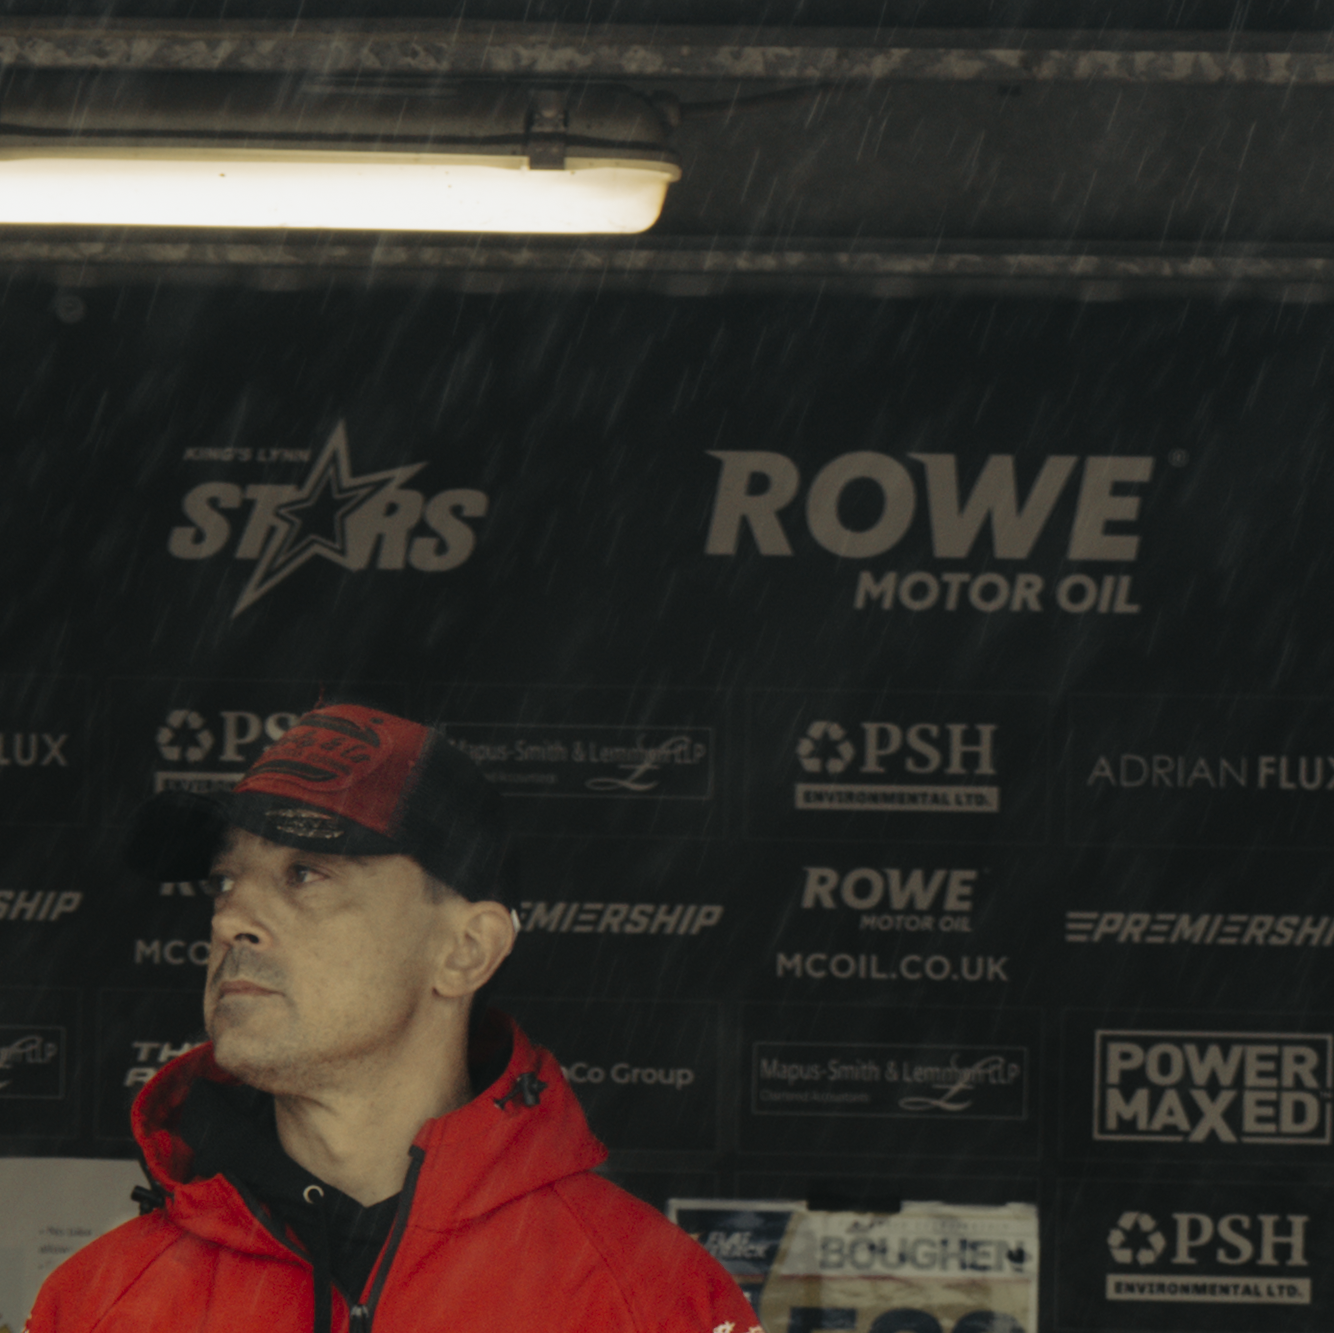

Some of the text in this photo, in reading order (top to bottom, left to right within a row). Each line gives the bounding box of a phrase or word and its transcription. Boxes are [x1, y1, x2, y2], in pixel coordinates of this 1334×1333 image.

[705, 450, 1155, 561] ROWE
[854, 570, 1141, 614] MOTOR OIL
[860, 723, 998, 777] PSH
[1087, 754, 1247, 789] ADRIAN
[802, 867, 978, 912] ROWE
[860, 913, 973, 933] MOTOR OIL
[775, 951, 1009, 982] MCOIL.CO.UK
[610, 1061, 694, 1089] Group
[884, 1062, 898, 1082] &
[1107, 1043, 1319, 1089] POWER
[1105, 1088, 1320, 1142] MAXED
[1172, 1213, 1310, 1267] PSH
[1113, 1281, 1262, 1297] ENVIRONMENTAL
